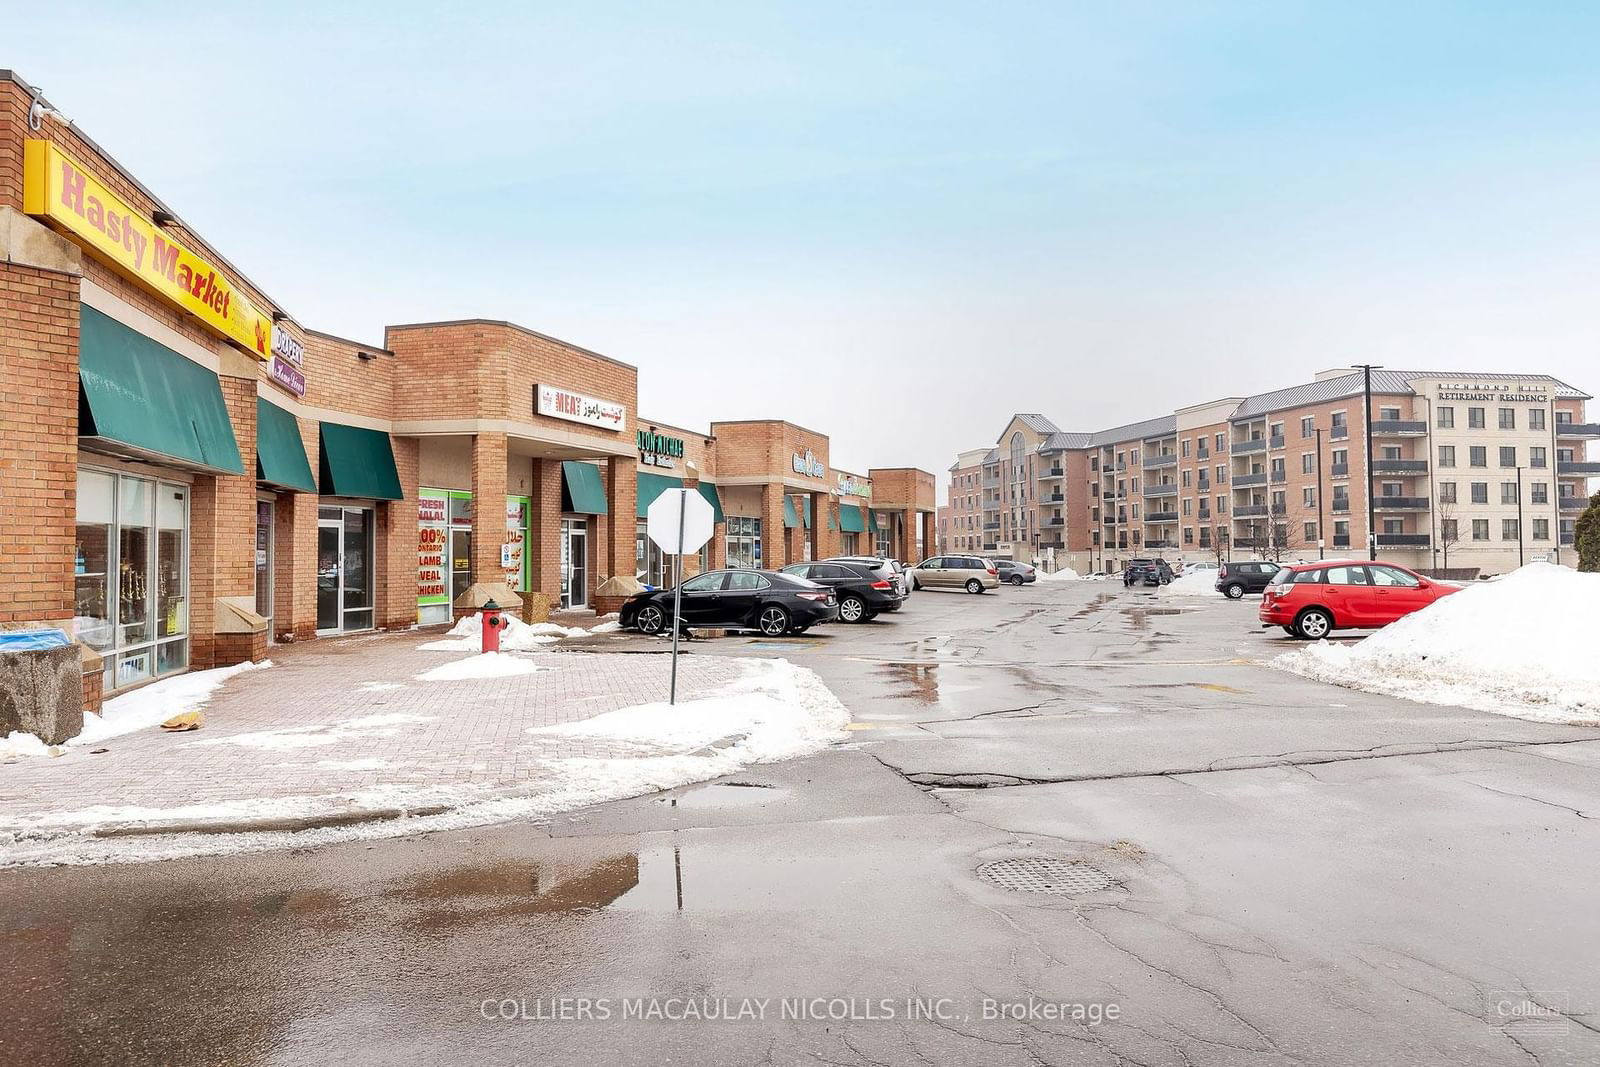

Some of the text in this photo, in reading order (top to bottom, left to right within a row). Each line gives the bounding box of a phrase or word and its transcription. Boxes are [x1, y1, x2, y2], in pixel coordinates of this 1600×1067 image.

[61, 160, 147, 271] Hasty
[153, 233, 231, 319] Market
[1438, 384, 1548, 393] RICHMOND HILL
[1438, 392, 1548, 403] RETIREMENT RESIDENCE
[419, 529, 446, 544] 00%
[419, 556, 441, 566] LAMB
[420, 570, 441, 581] VEAL
